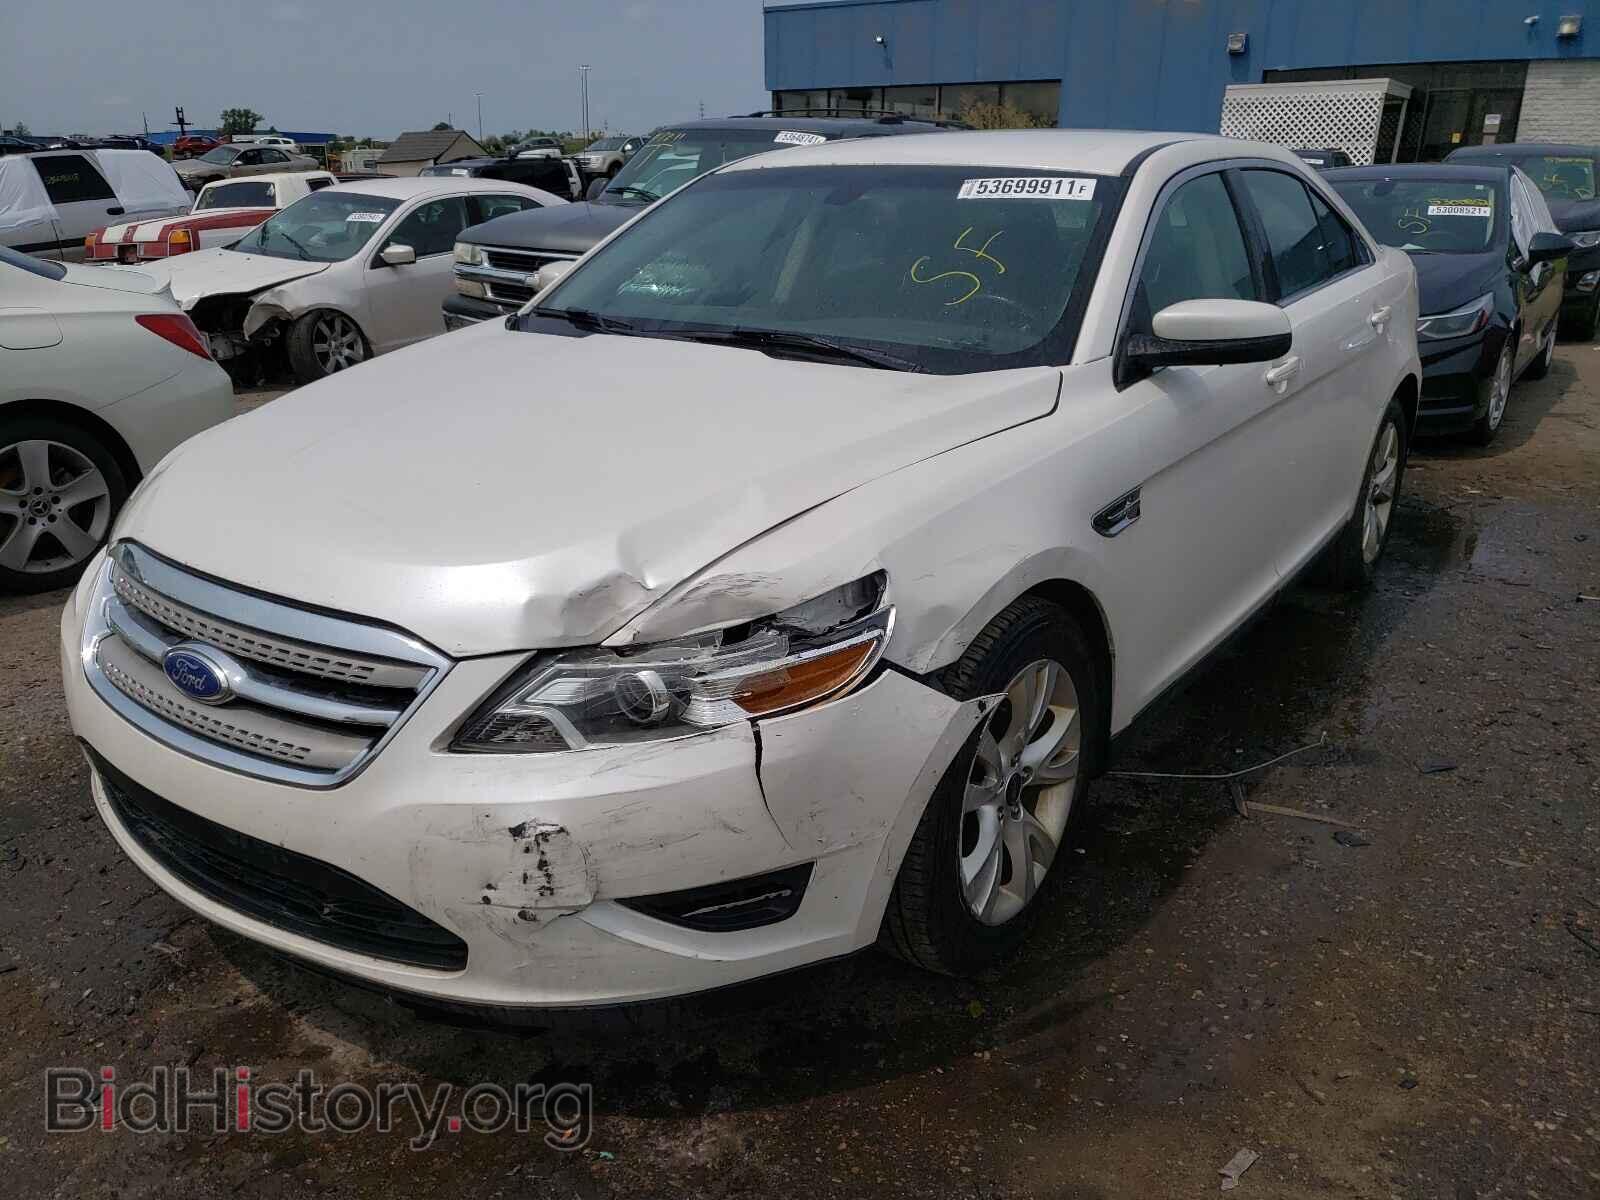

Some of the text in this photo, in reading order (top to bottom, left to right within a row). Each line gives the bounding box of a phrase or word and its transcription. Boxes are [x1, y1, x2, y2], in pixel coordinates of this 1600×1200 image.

[976, 179, 1076, 195] 53699911
[1436, 206, 1482, 215] 53008521
[172, 658, 208, 691] Ford
